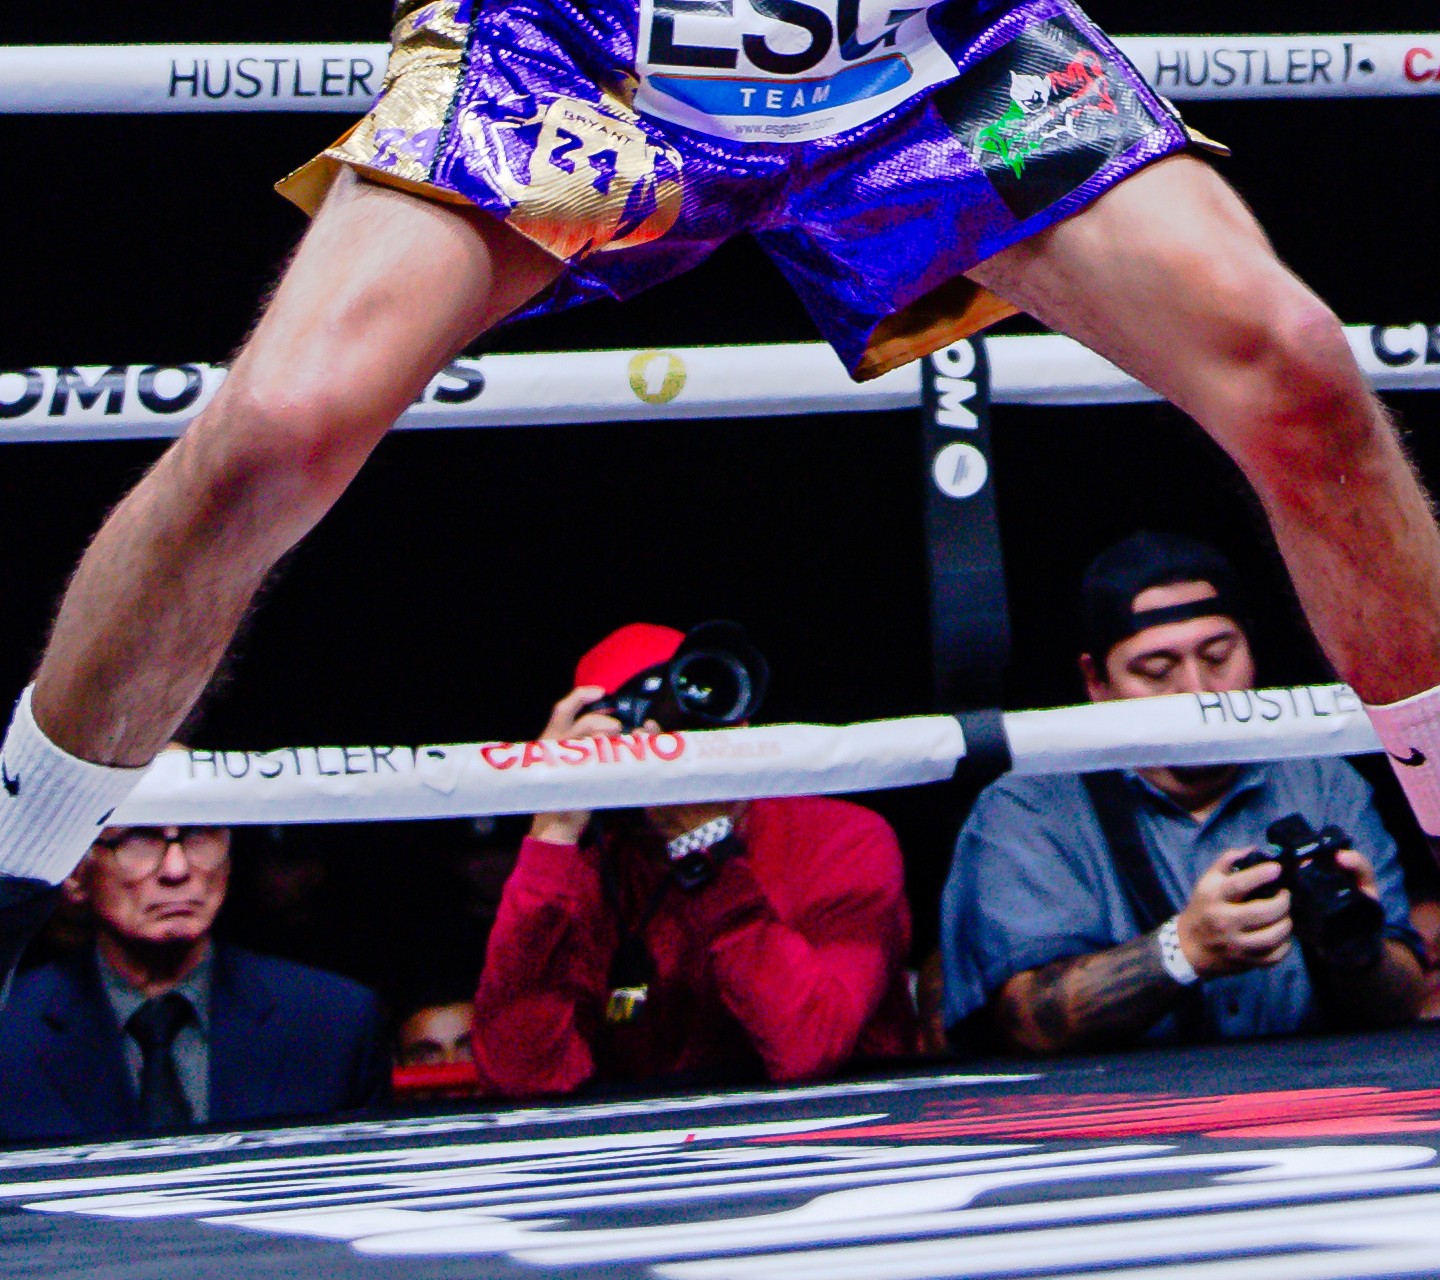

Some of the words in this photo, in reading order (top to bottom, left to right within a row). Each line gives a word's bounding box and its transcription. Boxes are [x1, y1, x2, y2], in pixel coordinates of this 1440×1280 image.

[169, 57, 375, 99] HUSTLER
[1154, 48, 1333, 87] HUSTLER
[738, 84, 831, 110] TEAM
[563, 109, 633, 146] BRYANT
[1196, 684, 1359, 724] HUSTLE
[187, 746, 398, 779] HUSTLER
[480, 731, 687, 771] CASINO
